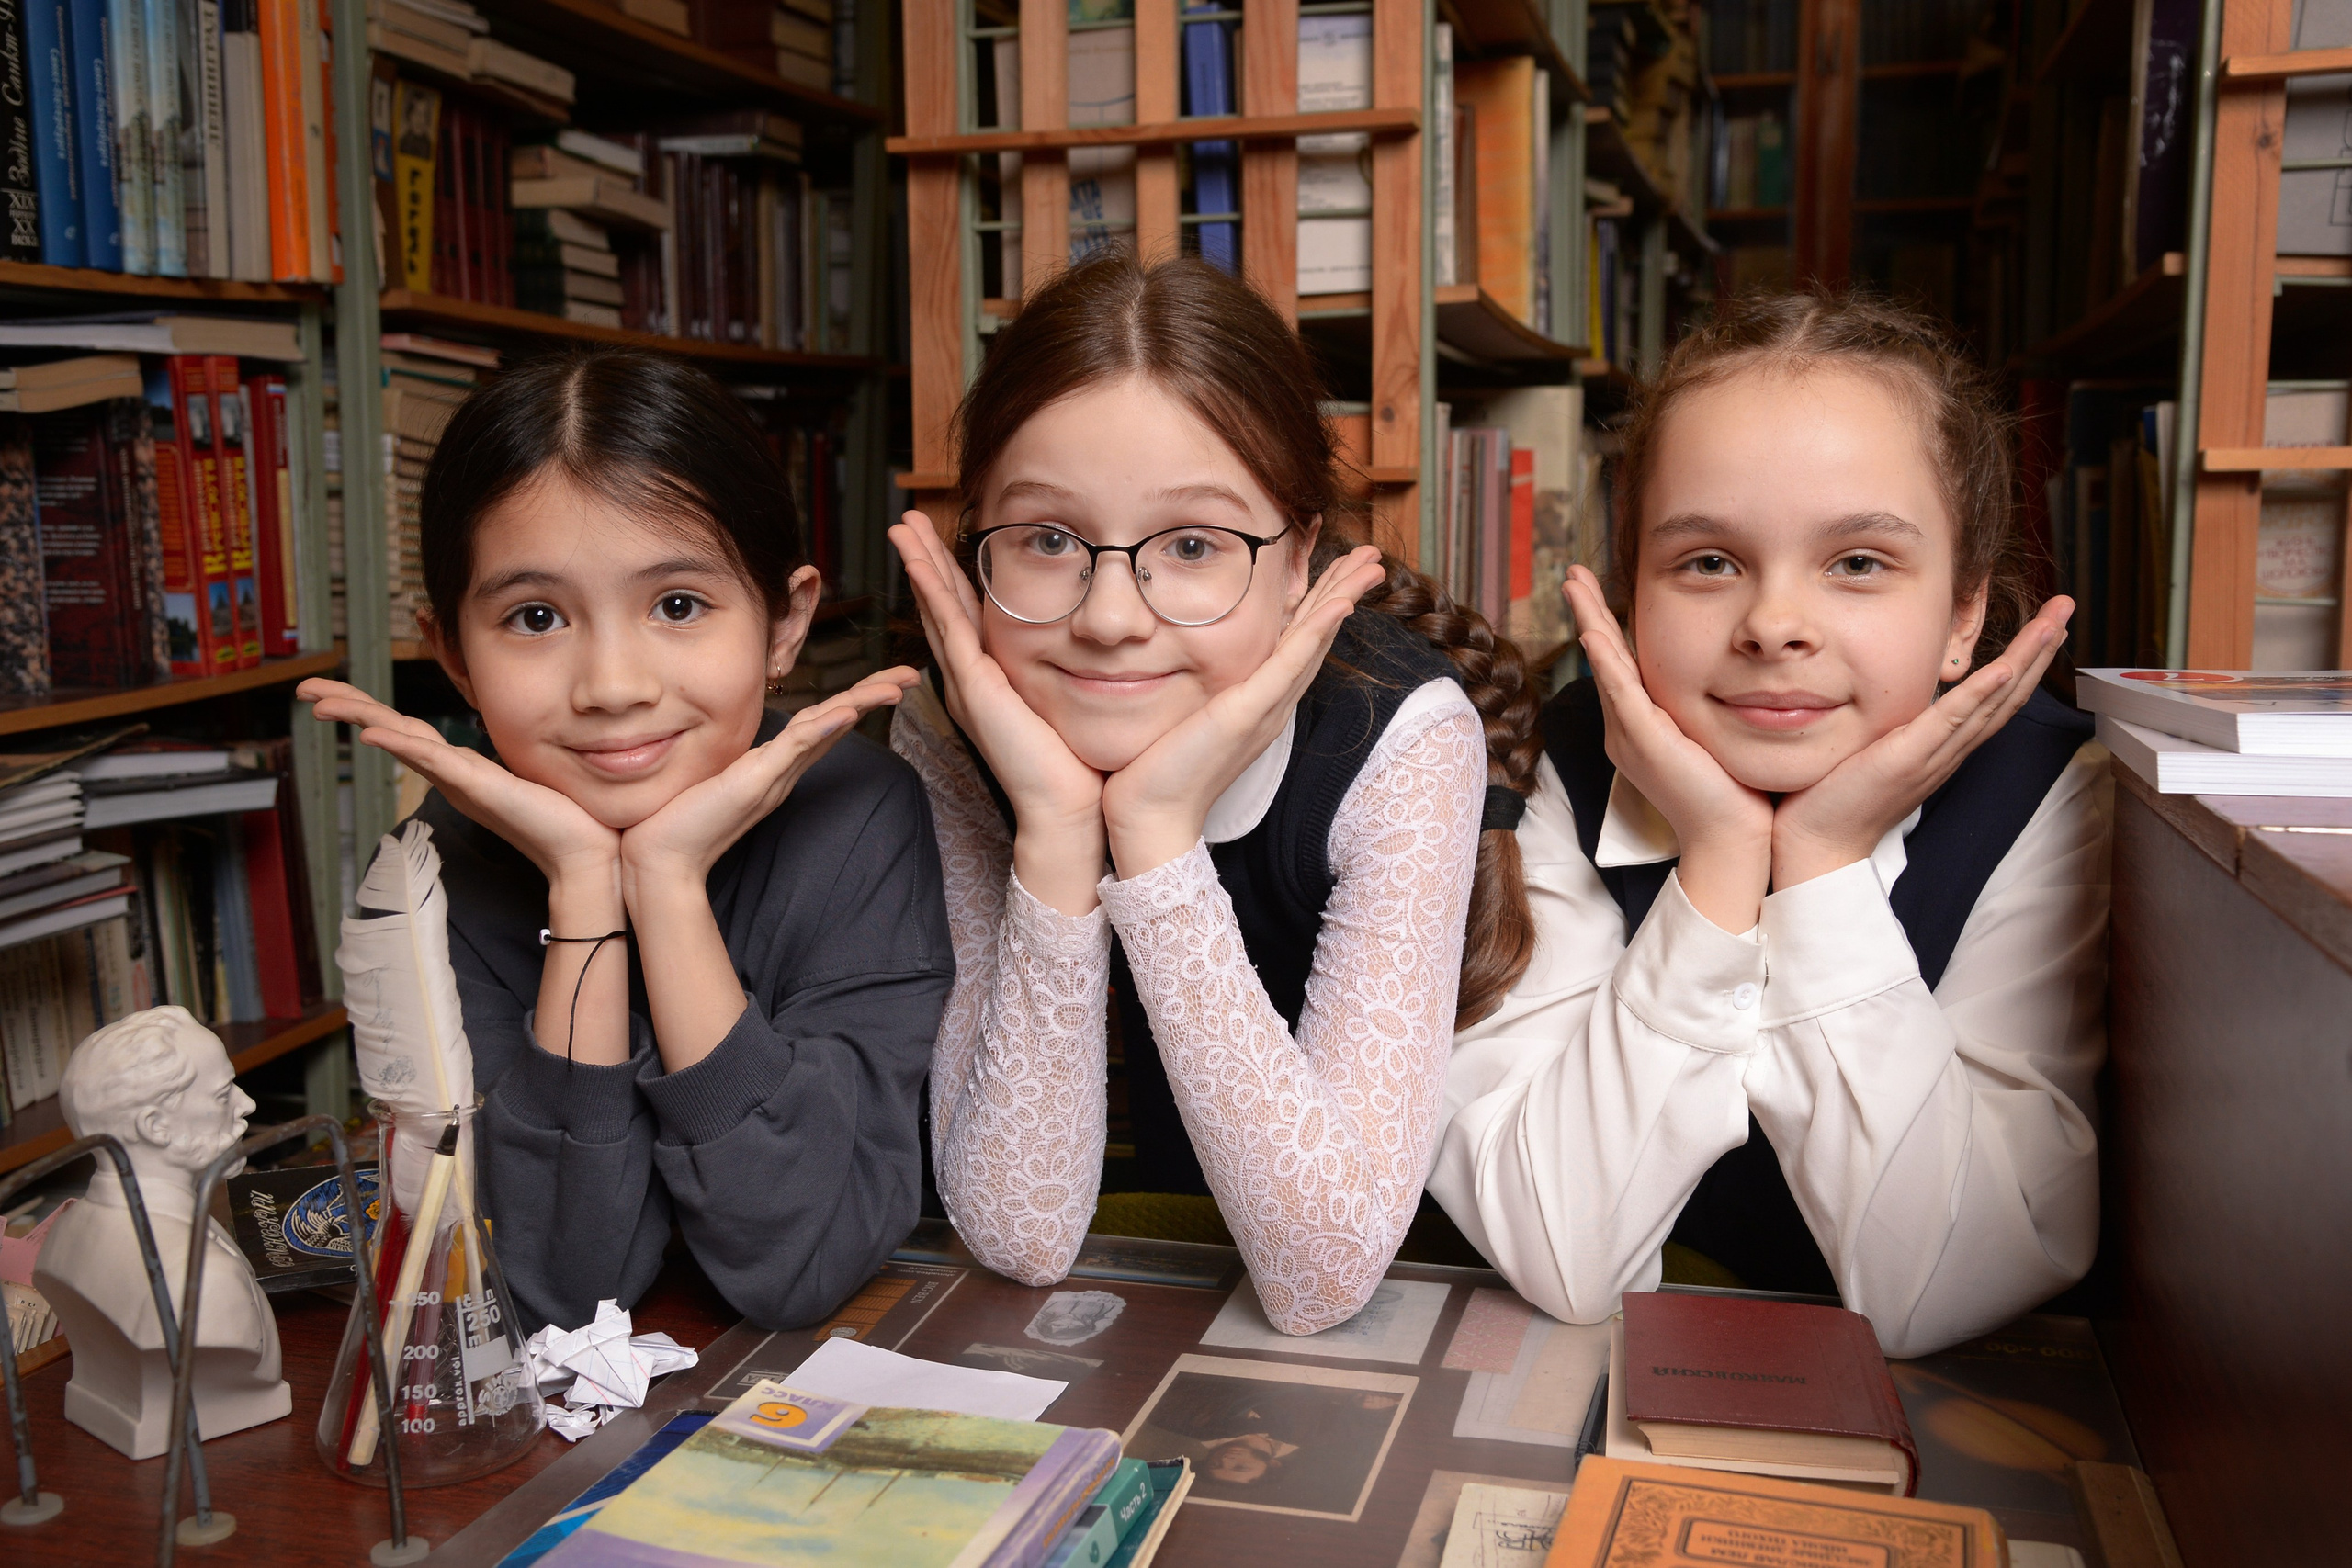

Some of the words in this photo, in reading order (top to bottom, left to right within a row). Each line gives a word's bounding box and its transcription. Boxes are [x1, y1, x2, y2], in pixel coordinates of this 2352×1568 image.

[467, 1304, 501, 1332] 250
[403, 1345, 439, 1360] 200
[1651, 1366, 1808, 1385] МАЯКОВСКИЙ
[401, 1384, 437, 1400] 150
[760, 1387, 837, 1411] КЛАСС
[401, 1418, 435, 1434] 100
[749, 1402, 808, 1429] 6
[1118, 1495, 1142, 1522] Часть
